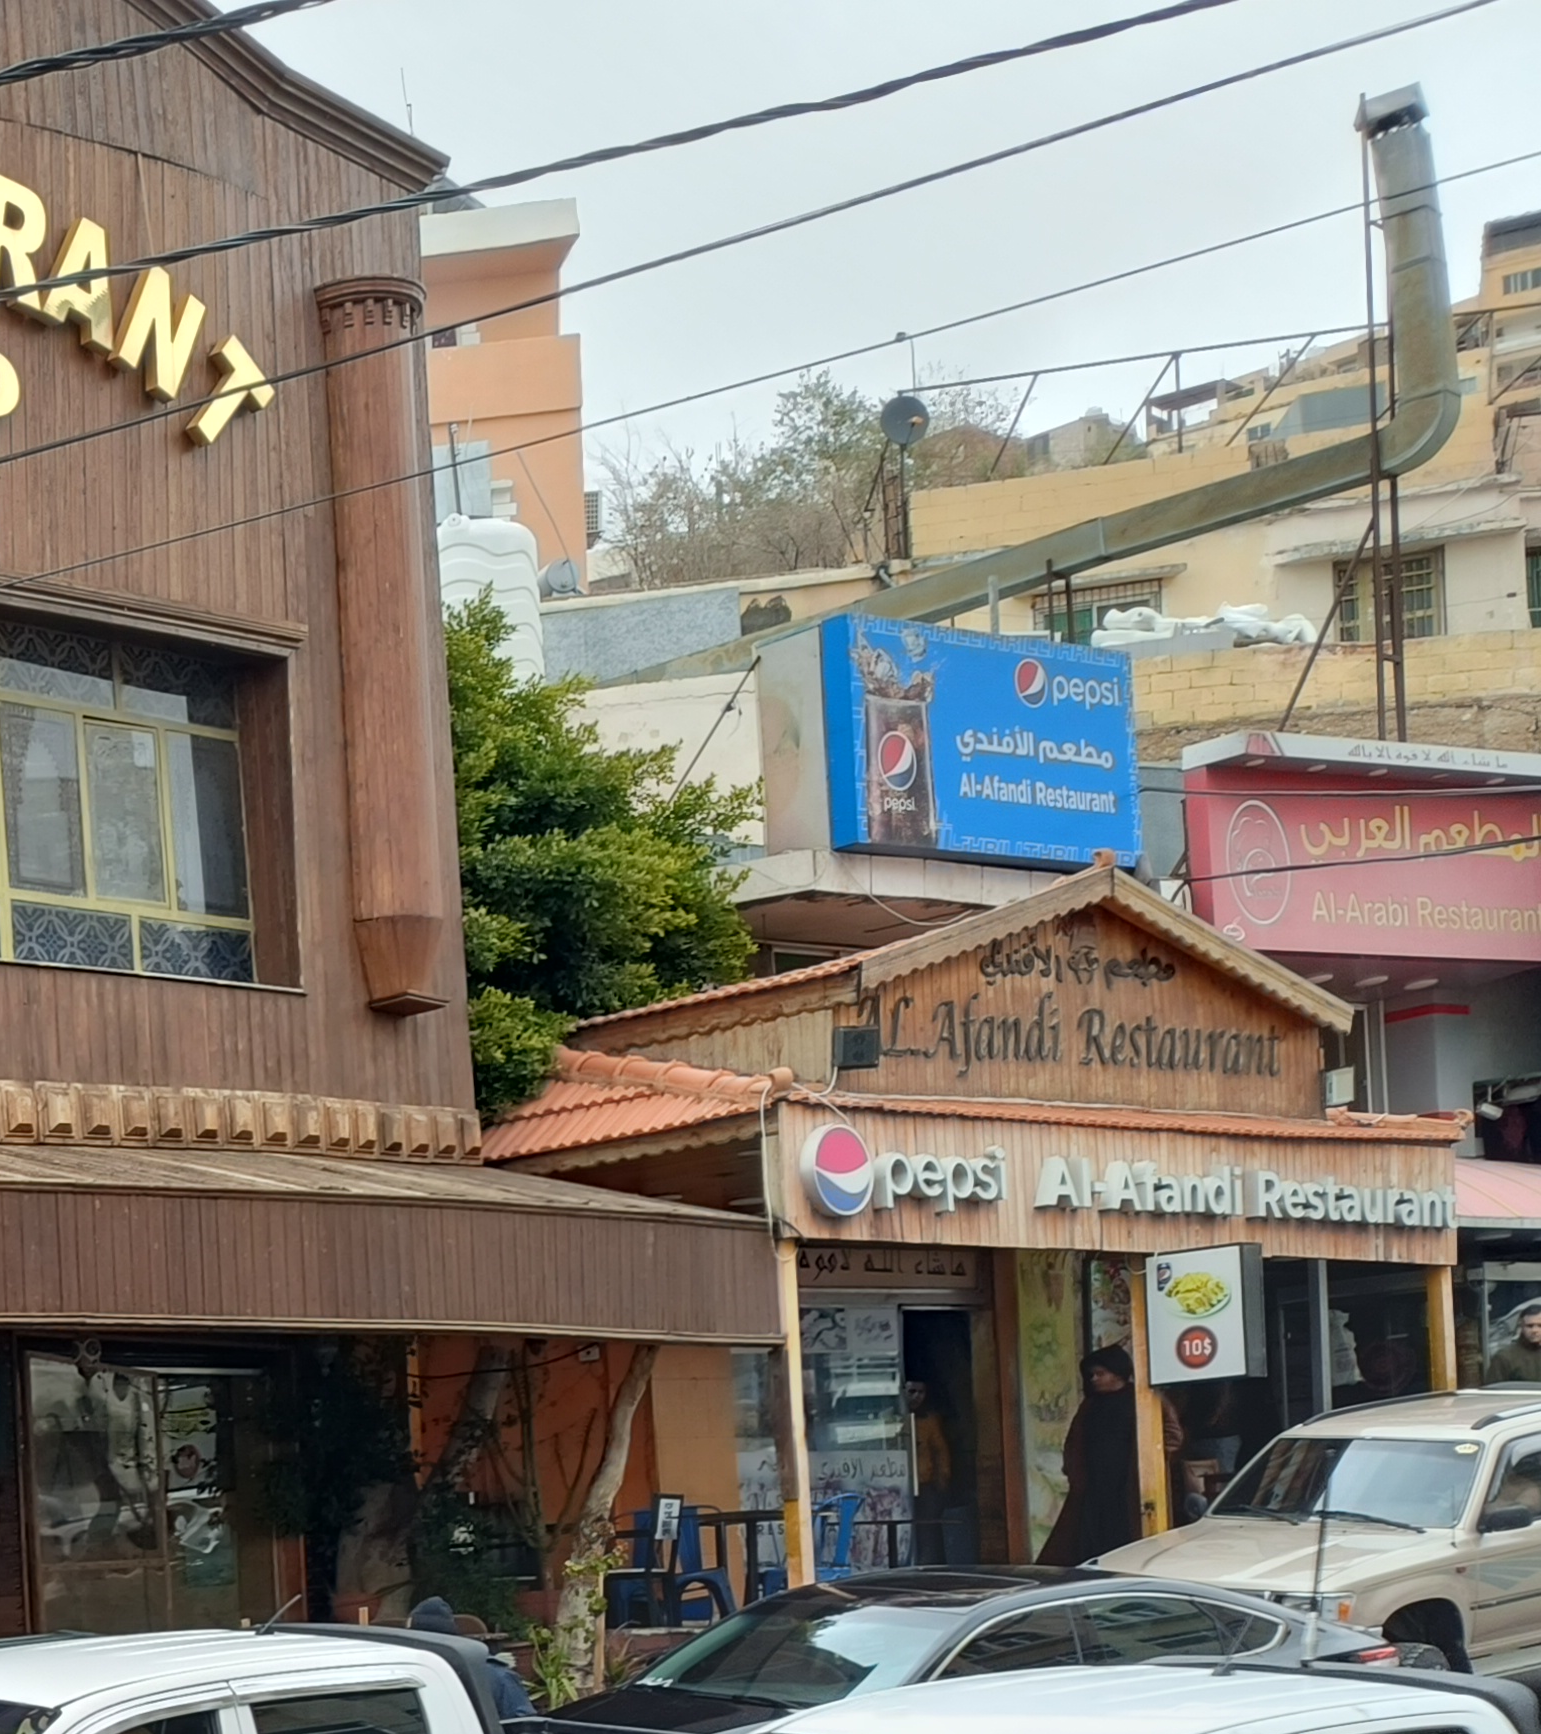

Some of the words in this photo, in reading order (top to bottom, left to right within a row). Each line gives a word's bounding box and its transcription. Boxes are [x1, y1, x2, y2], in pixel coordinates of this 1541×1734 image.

[1052, 675, 1121, 709] pepsi
[955, 726, 1035, 763] الأفندي
[1038, 738, 1114, 770] مطعم
[883, 796, 916, 812] pepsi
[959, 771, 1033, 805] Al-Afandi
[1035, 780, 1116, 814] Restaurant
[1419, 810, 1541, 862] لمطعم
[1311, 890, 1410, 928] Al-Arabi
[1077, 1006, 1281, 1077] Restaurant
[873, 1145, 1006, 1214] pepsi
[1034, 1155, 1245, 1217] Al-Afandi
[1246, 1168, 1457, 1229] Restaurant
[1182, 1337, 1213, 1357] 10$
